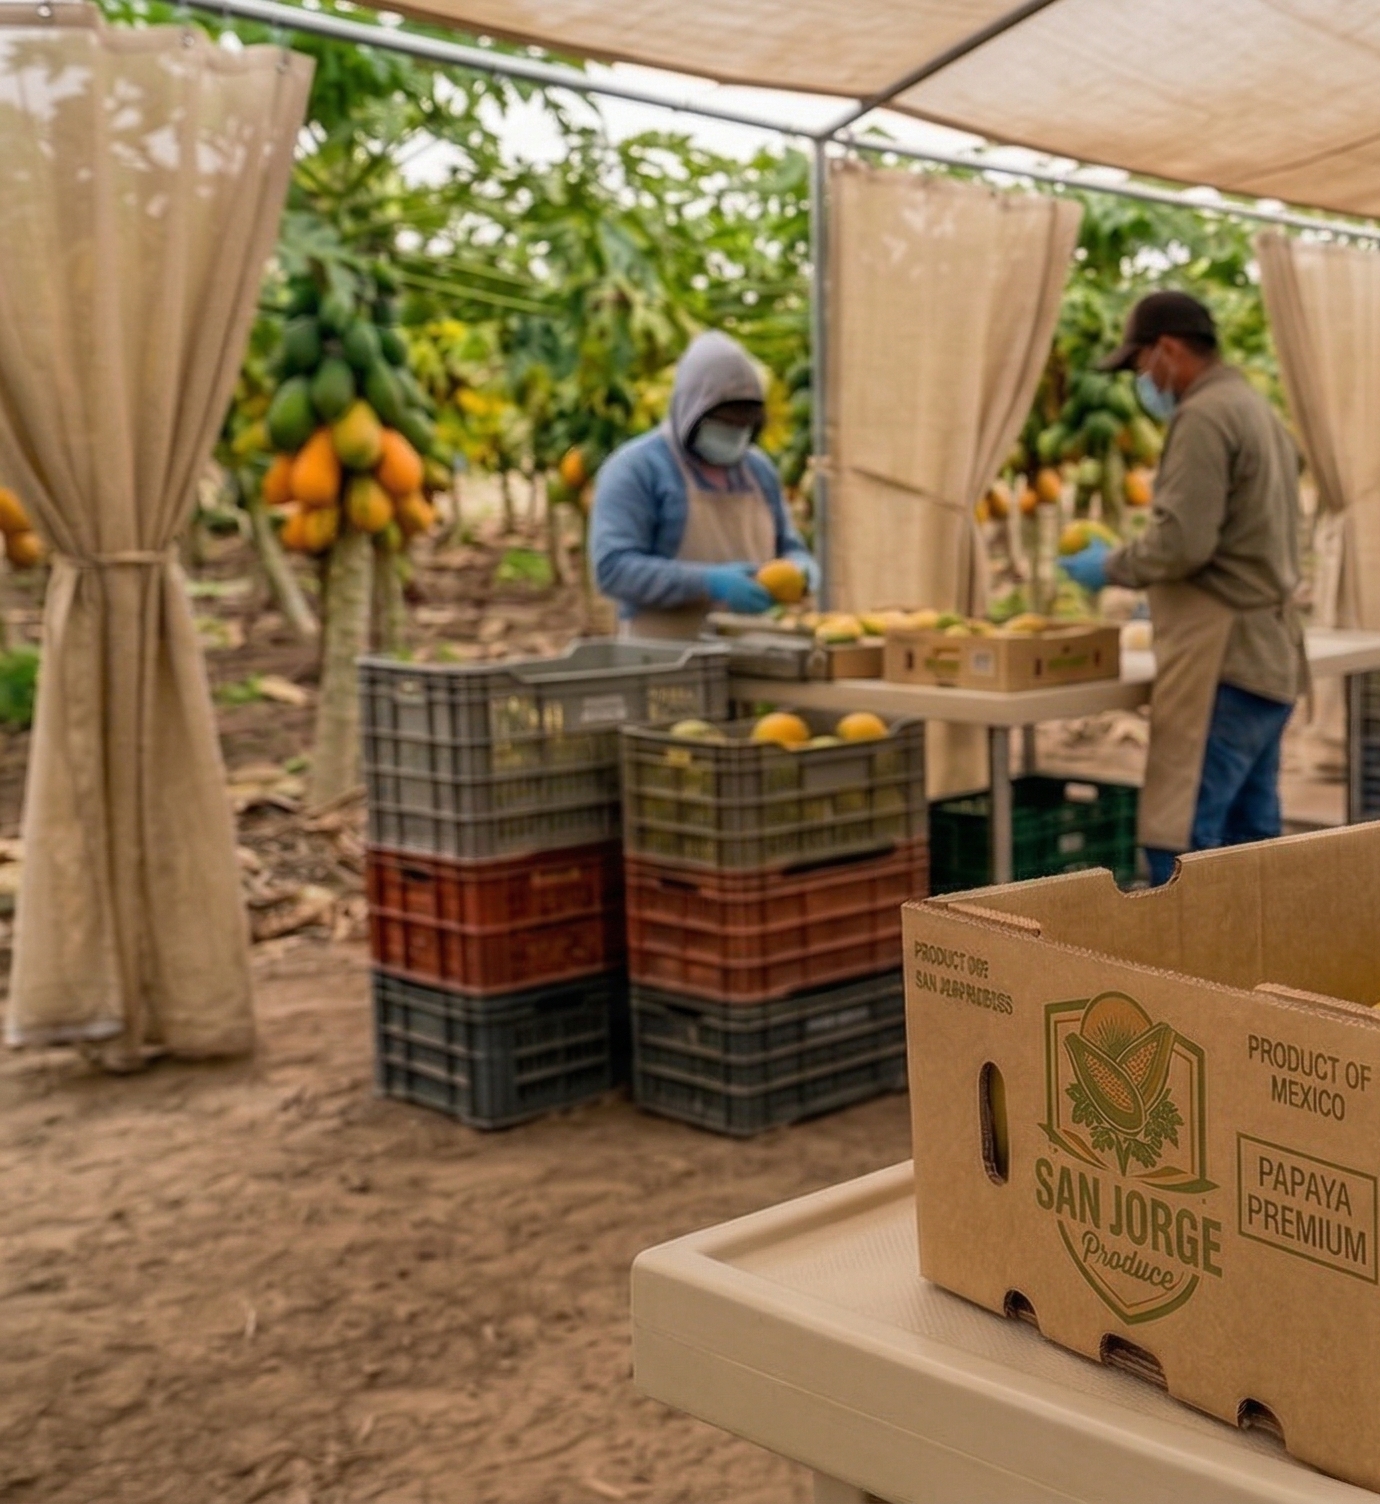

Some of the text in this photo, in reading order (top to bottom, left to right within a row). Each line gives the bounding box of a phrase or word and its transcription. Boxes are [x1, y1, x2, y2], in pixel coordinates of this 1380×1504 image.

[916, 969, 937, 993] SAN
[1248, 1034, 1372, 1092] PRODUCT OF
[1271, 1074, 1346, 1122] MEXICO
[1259, 1155, 1352, 1217] PAPAYA
[1035, 1157, 1223, 1279] SAN JORGE
[1248, 1193, 1367, 1266] PREMIUM
[1081, 1230, 1177, 1291] Produce
